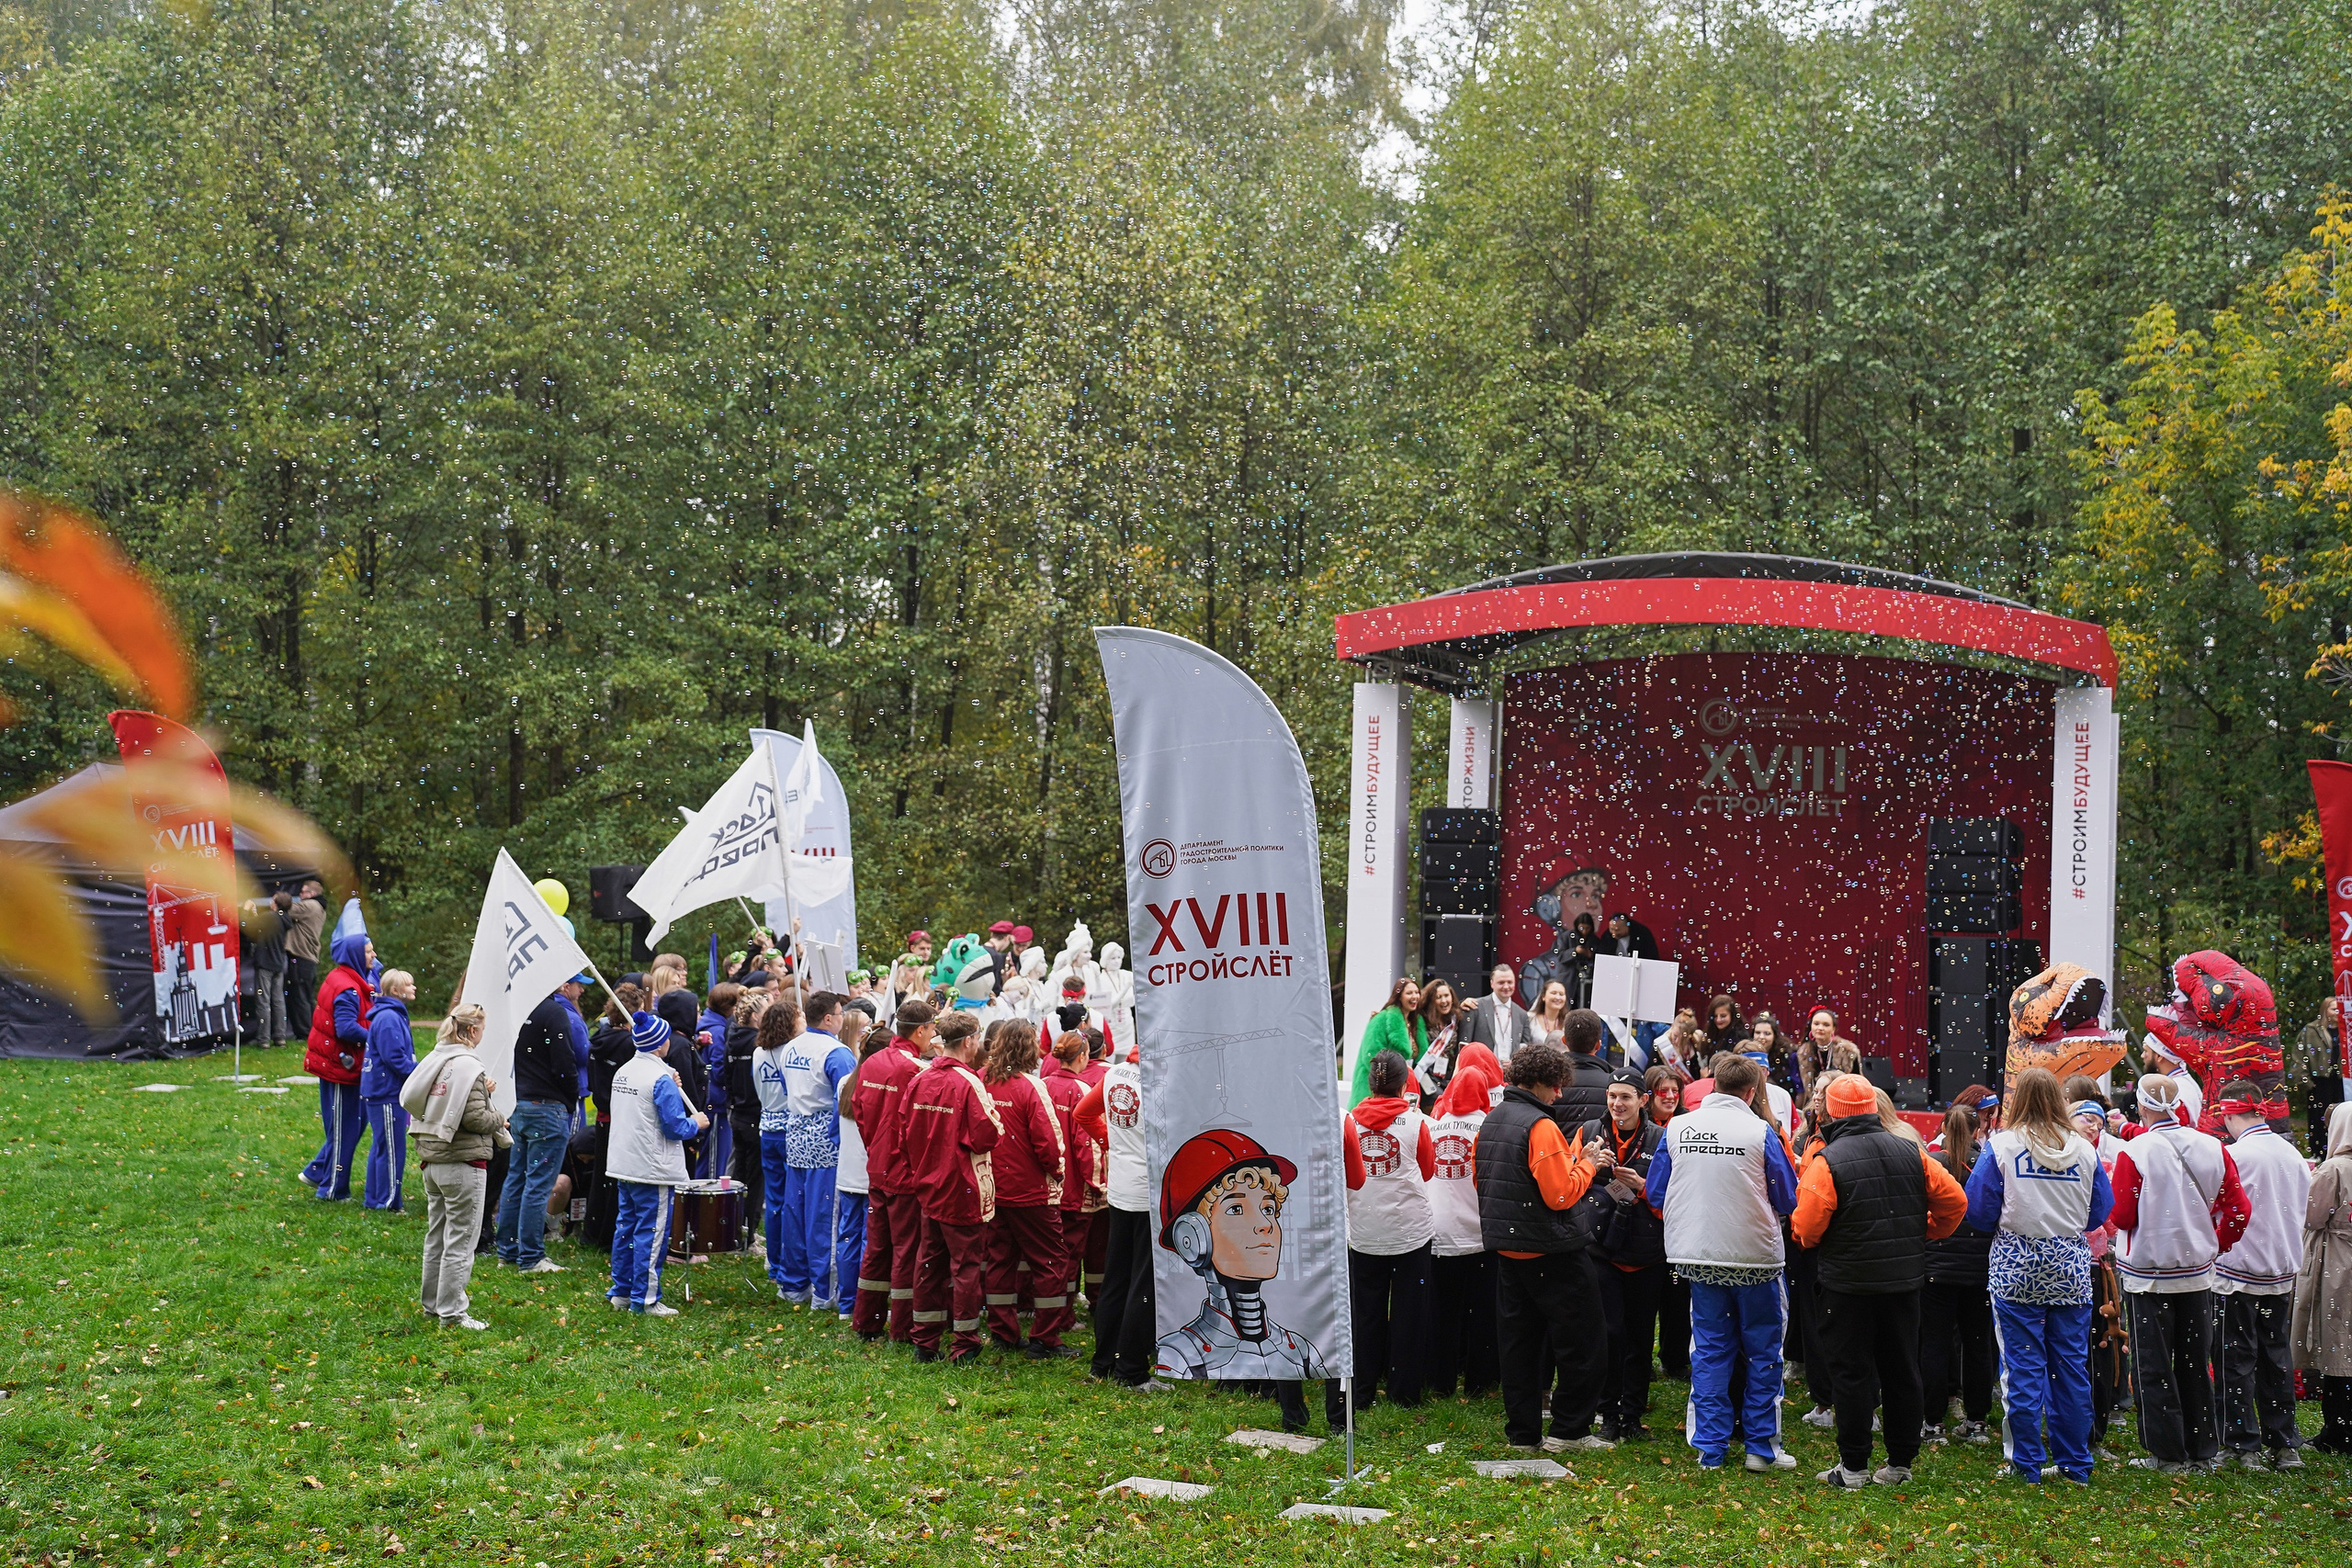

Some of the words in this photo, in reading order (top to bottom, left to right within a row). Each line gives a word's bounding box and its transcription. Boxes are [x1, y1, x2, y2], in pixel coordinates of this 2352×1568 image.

[1698, 743, 1847, 793] XVIII
[1363, 715, 1381, 876] #СТРОИМБУДУЩЕЕ
[1696, 792, 1847, 817] СТРОЙСЛЁТ
[2072, 722, 2092, 899] #СТРОИМБУДУЩЕЕ
[150, 820, 216, 853] XVIII
[1180, 840, 1224, 851] ДЕПАРТАМЕНТ
[1180, 844, 1250, 858] ГРАДОСТРОИТЕЛЬНОЙ
[1180, 856, 1207, 865] ГОРОДА
[1207, 854, 1238, 863] МОСКВЫ
[1145, 892, 1290, 956] XVIII
[1148, 950, 1294, 987] СТРОЙСЛЁТ
